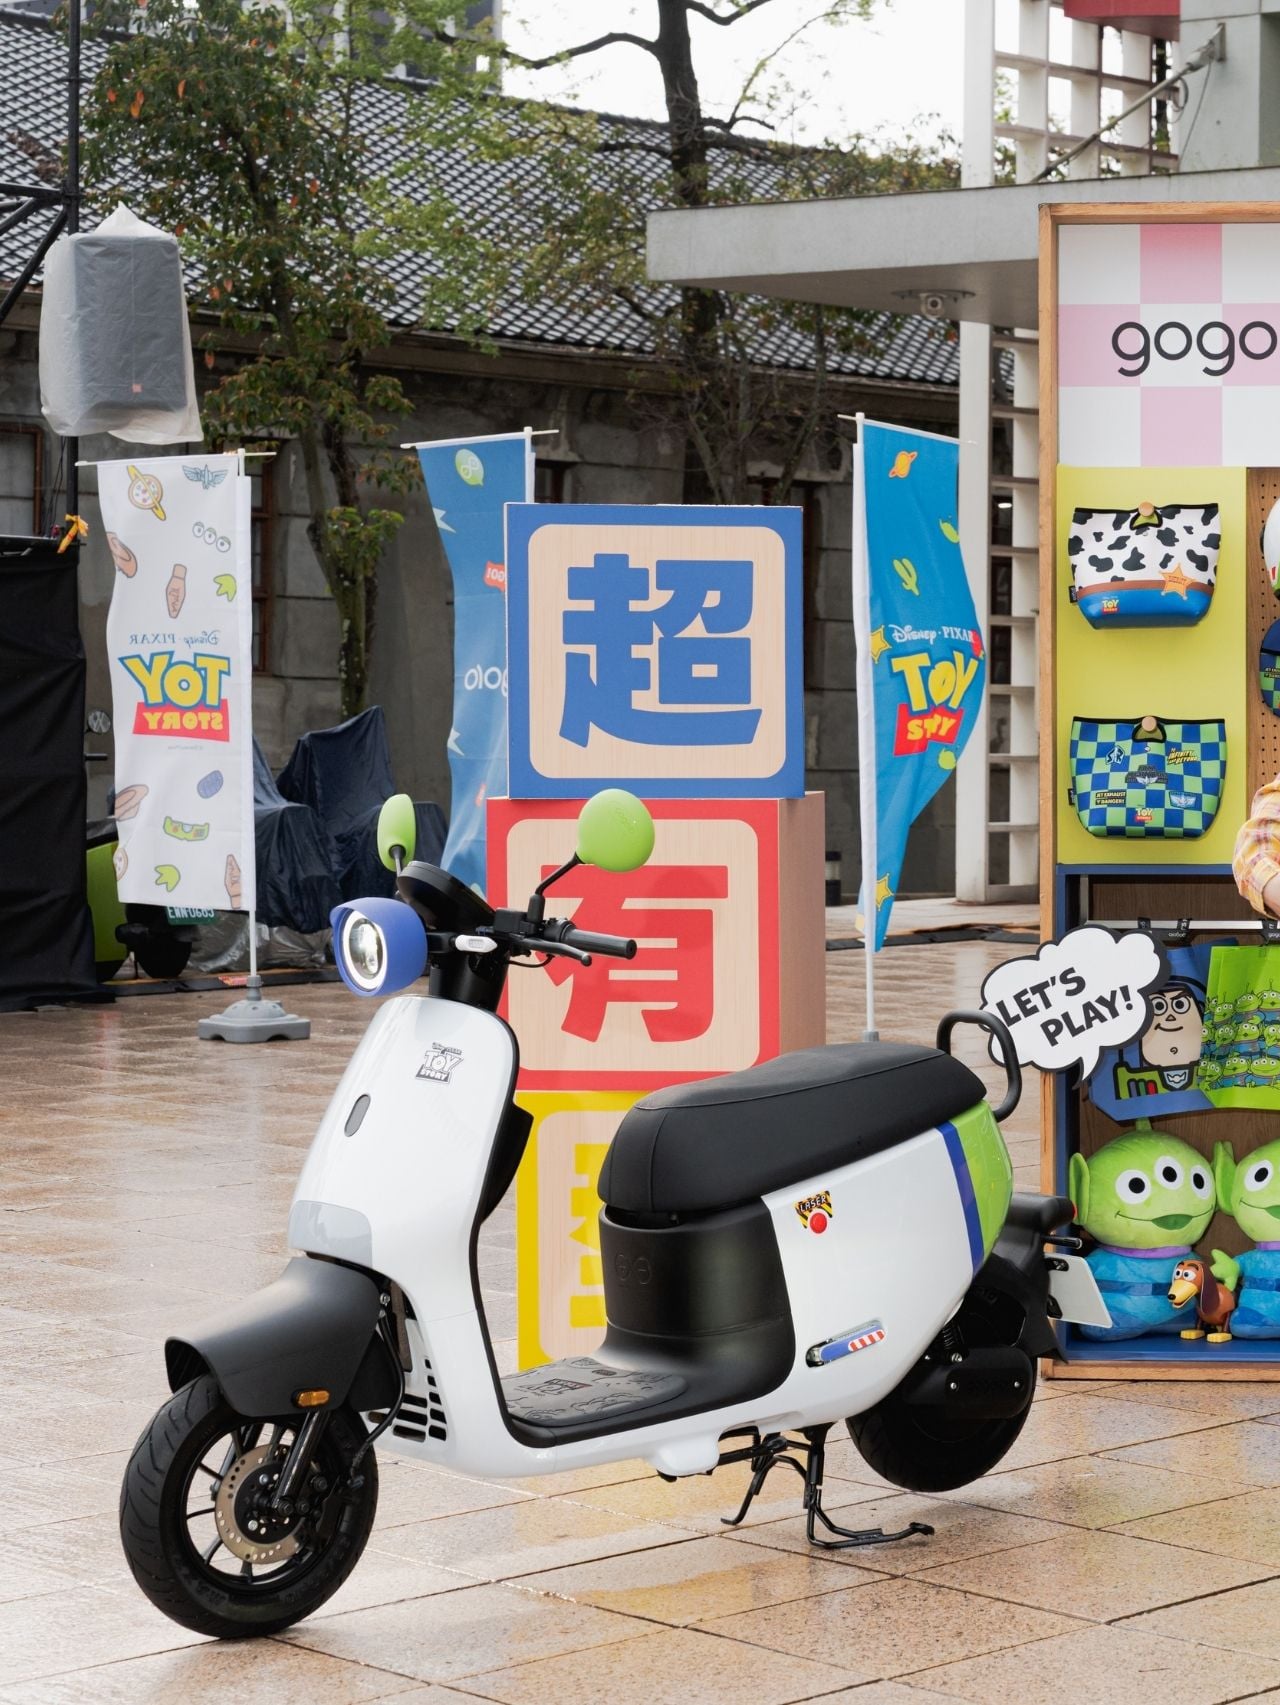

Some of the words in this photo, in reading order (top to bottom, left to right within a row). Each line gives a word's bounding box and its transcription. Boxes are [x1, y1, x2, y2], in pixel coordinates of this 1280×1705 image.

[559, 553, 762, 748] 超
[888, 624, 937, 645] Disney
[890, 650, 979, 712] TOY
[535, 862, 729, 1046] 有
[996, 967, 1086, 1027] LET'S
[1040, 985, 1133, 1047] PLAY!
[421, 1067, 448, 1080] STORY
[424, 1050, 464, 1073] TOY
[800, 1195, 826, 1212] LASER
